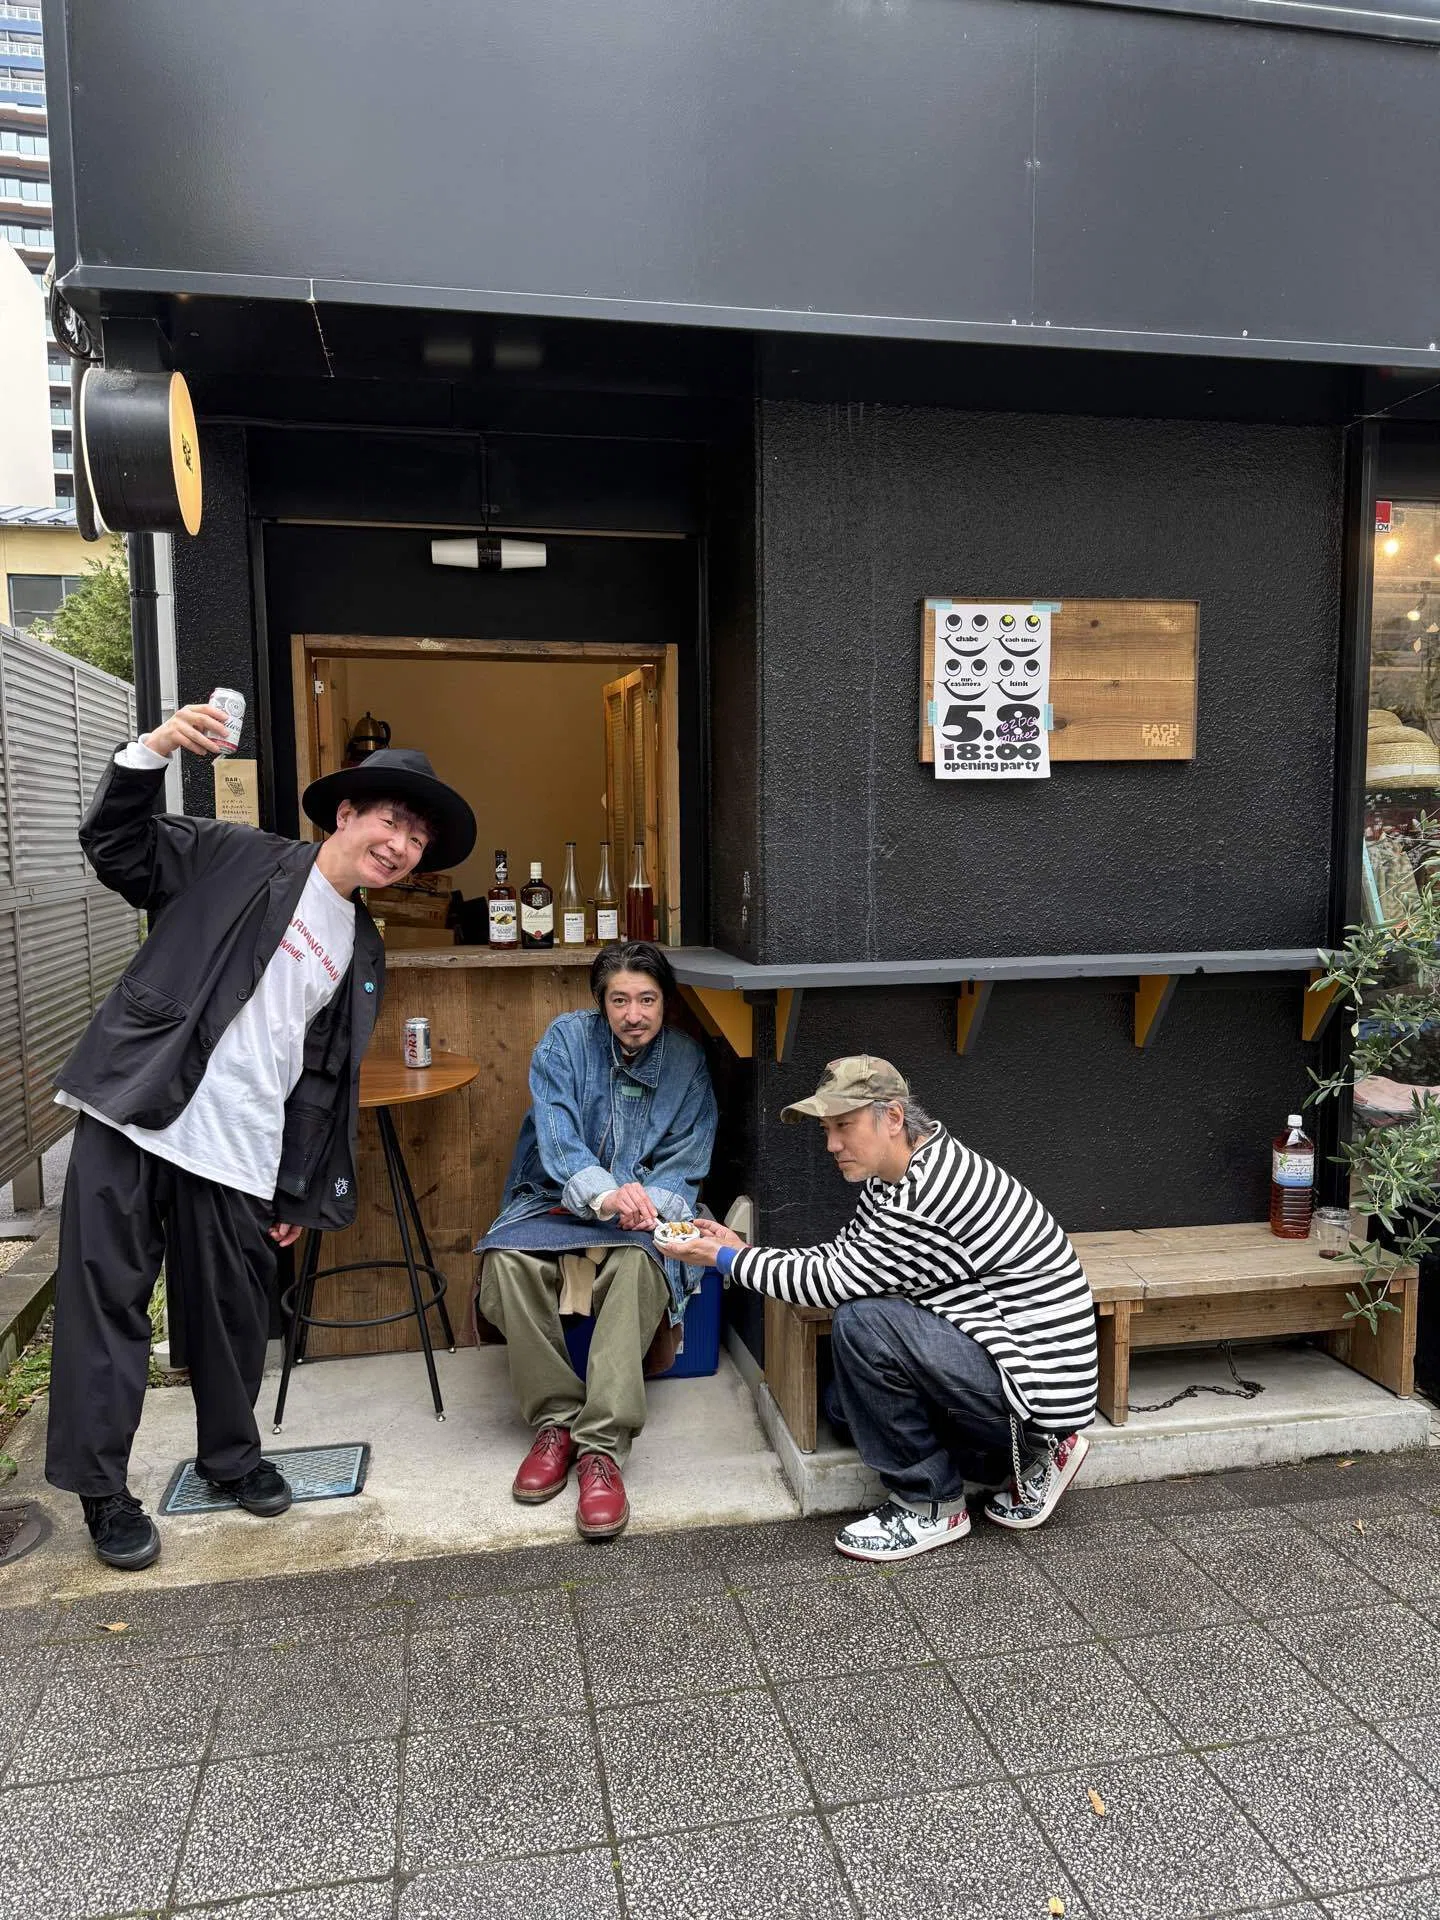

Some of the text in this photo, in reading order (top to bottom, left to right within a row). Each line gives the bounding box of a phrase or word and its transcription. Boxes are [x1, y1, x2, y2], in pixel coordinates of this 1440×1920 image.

[942, 703, 1040, 743] 5.8
[1141, 723, 1180, 737] EACH
[943, 760, 1040, 773] opening party
[321, 955, 340, 982] MAN
